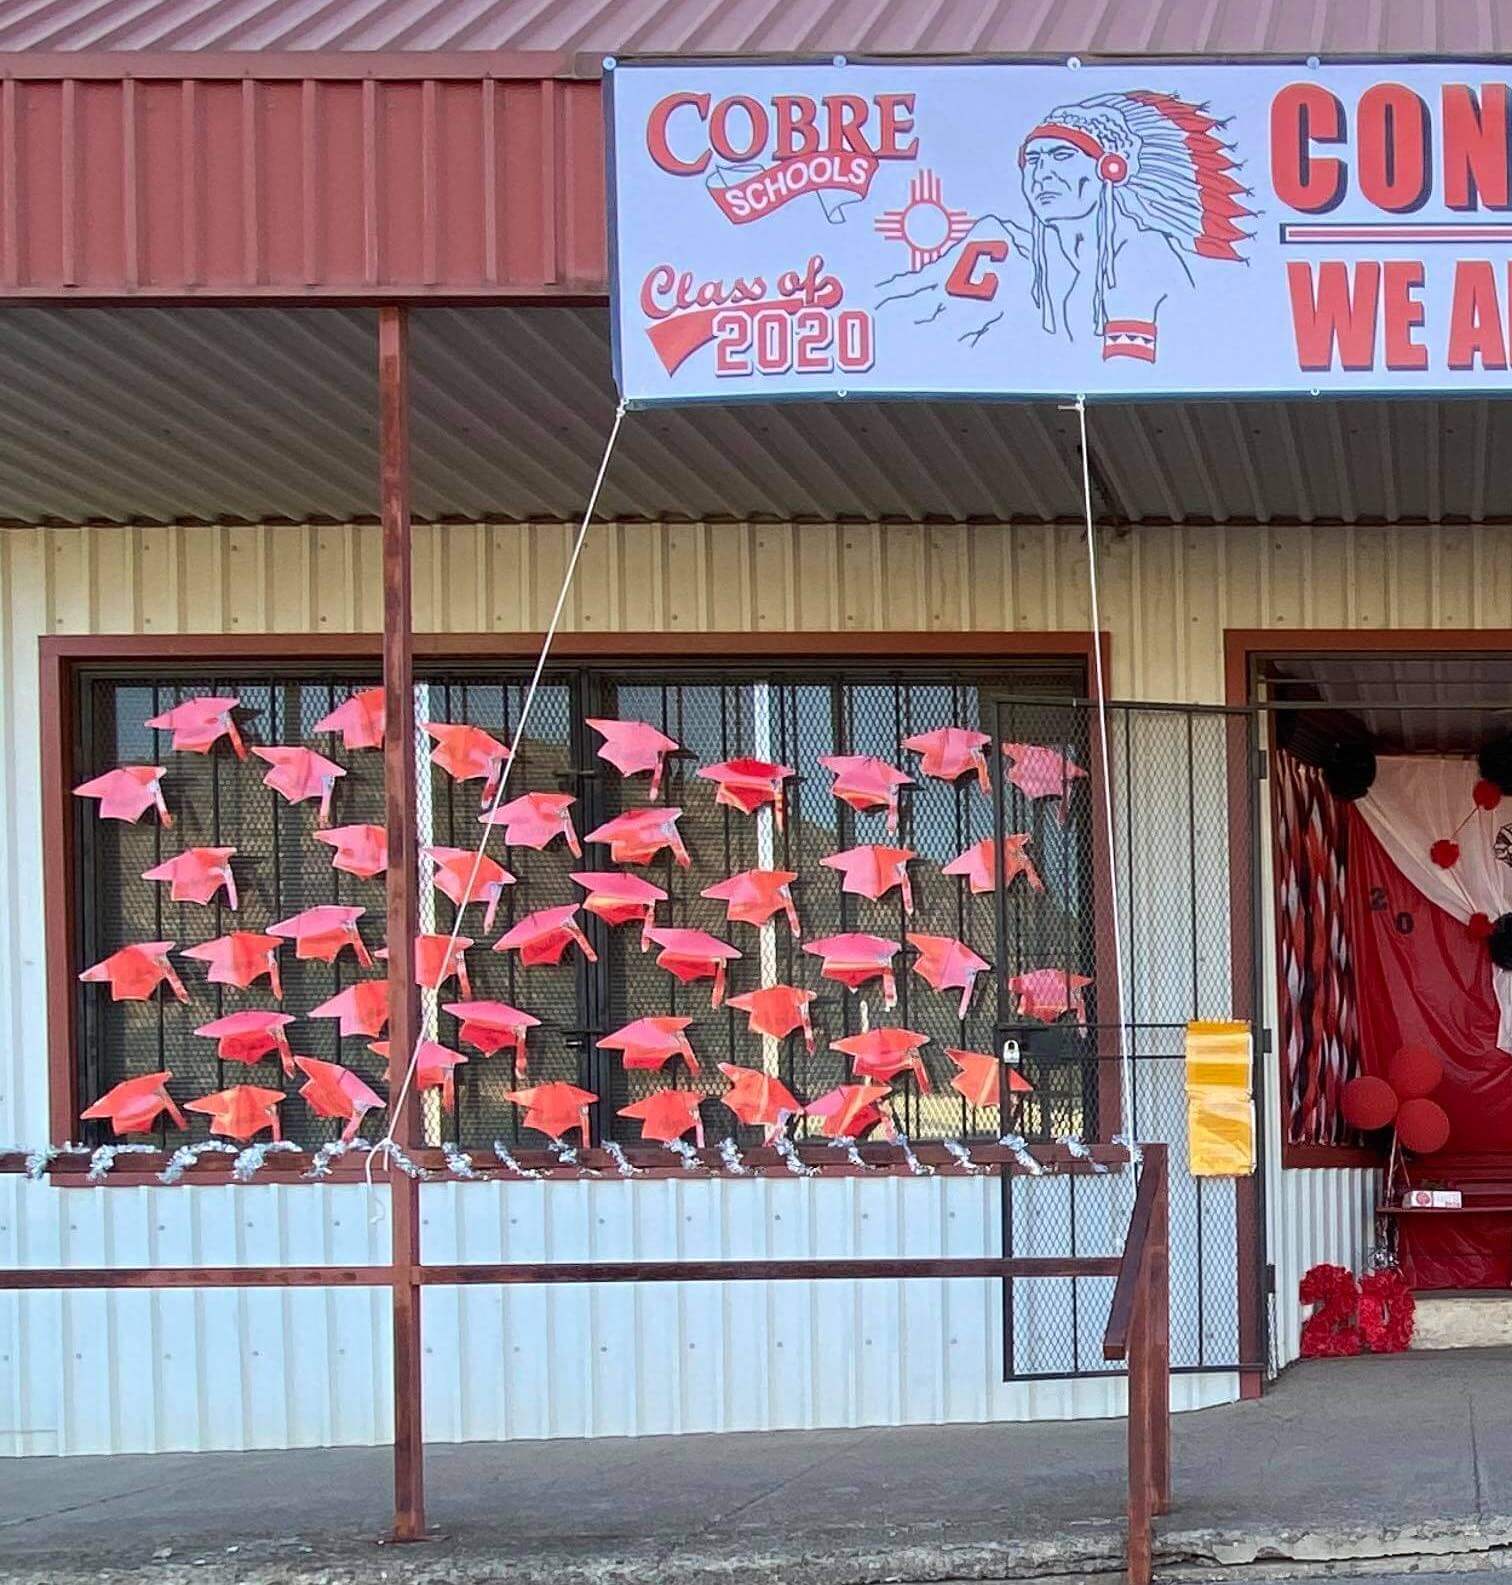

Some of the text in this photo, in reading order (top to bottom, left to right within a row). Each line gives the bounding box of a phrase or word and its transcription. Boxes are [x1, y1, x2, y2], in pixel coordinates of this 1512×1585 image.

[646, 91, 920, 177] COBRE
[725, 157, 869, 216] SCHOOLS
[640, 253, 844, 319] Class of
[945, 239, 1009, 301] C
[712, 308, 875, 377] 2020
[1286, 259, 1429, 371] WE
